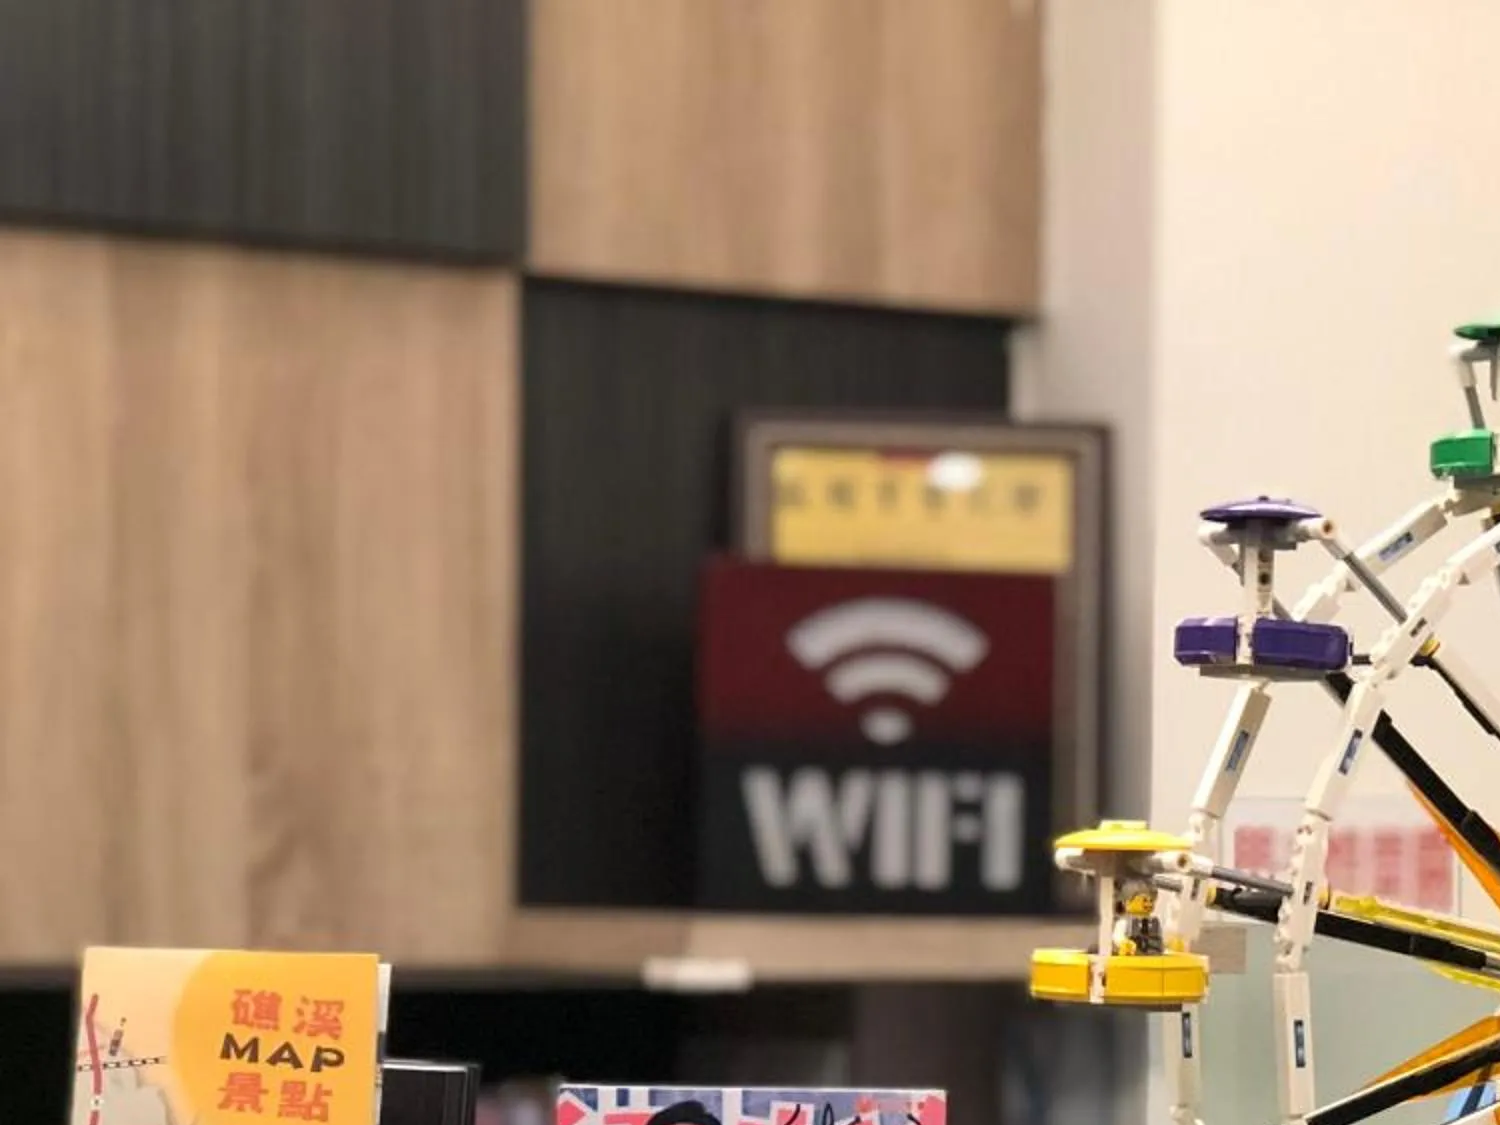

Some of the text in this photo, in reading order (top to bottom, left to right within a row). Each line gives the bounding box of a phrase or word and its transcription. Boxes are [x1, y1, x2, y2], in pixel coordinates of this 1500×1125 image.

[739, 766, 1025, 892] WIFI
[219, 1031, 346, 1073] MAP
[216, 1071, 333, 1123] 景點
